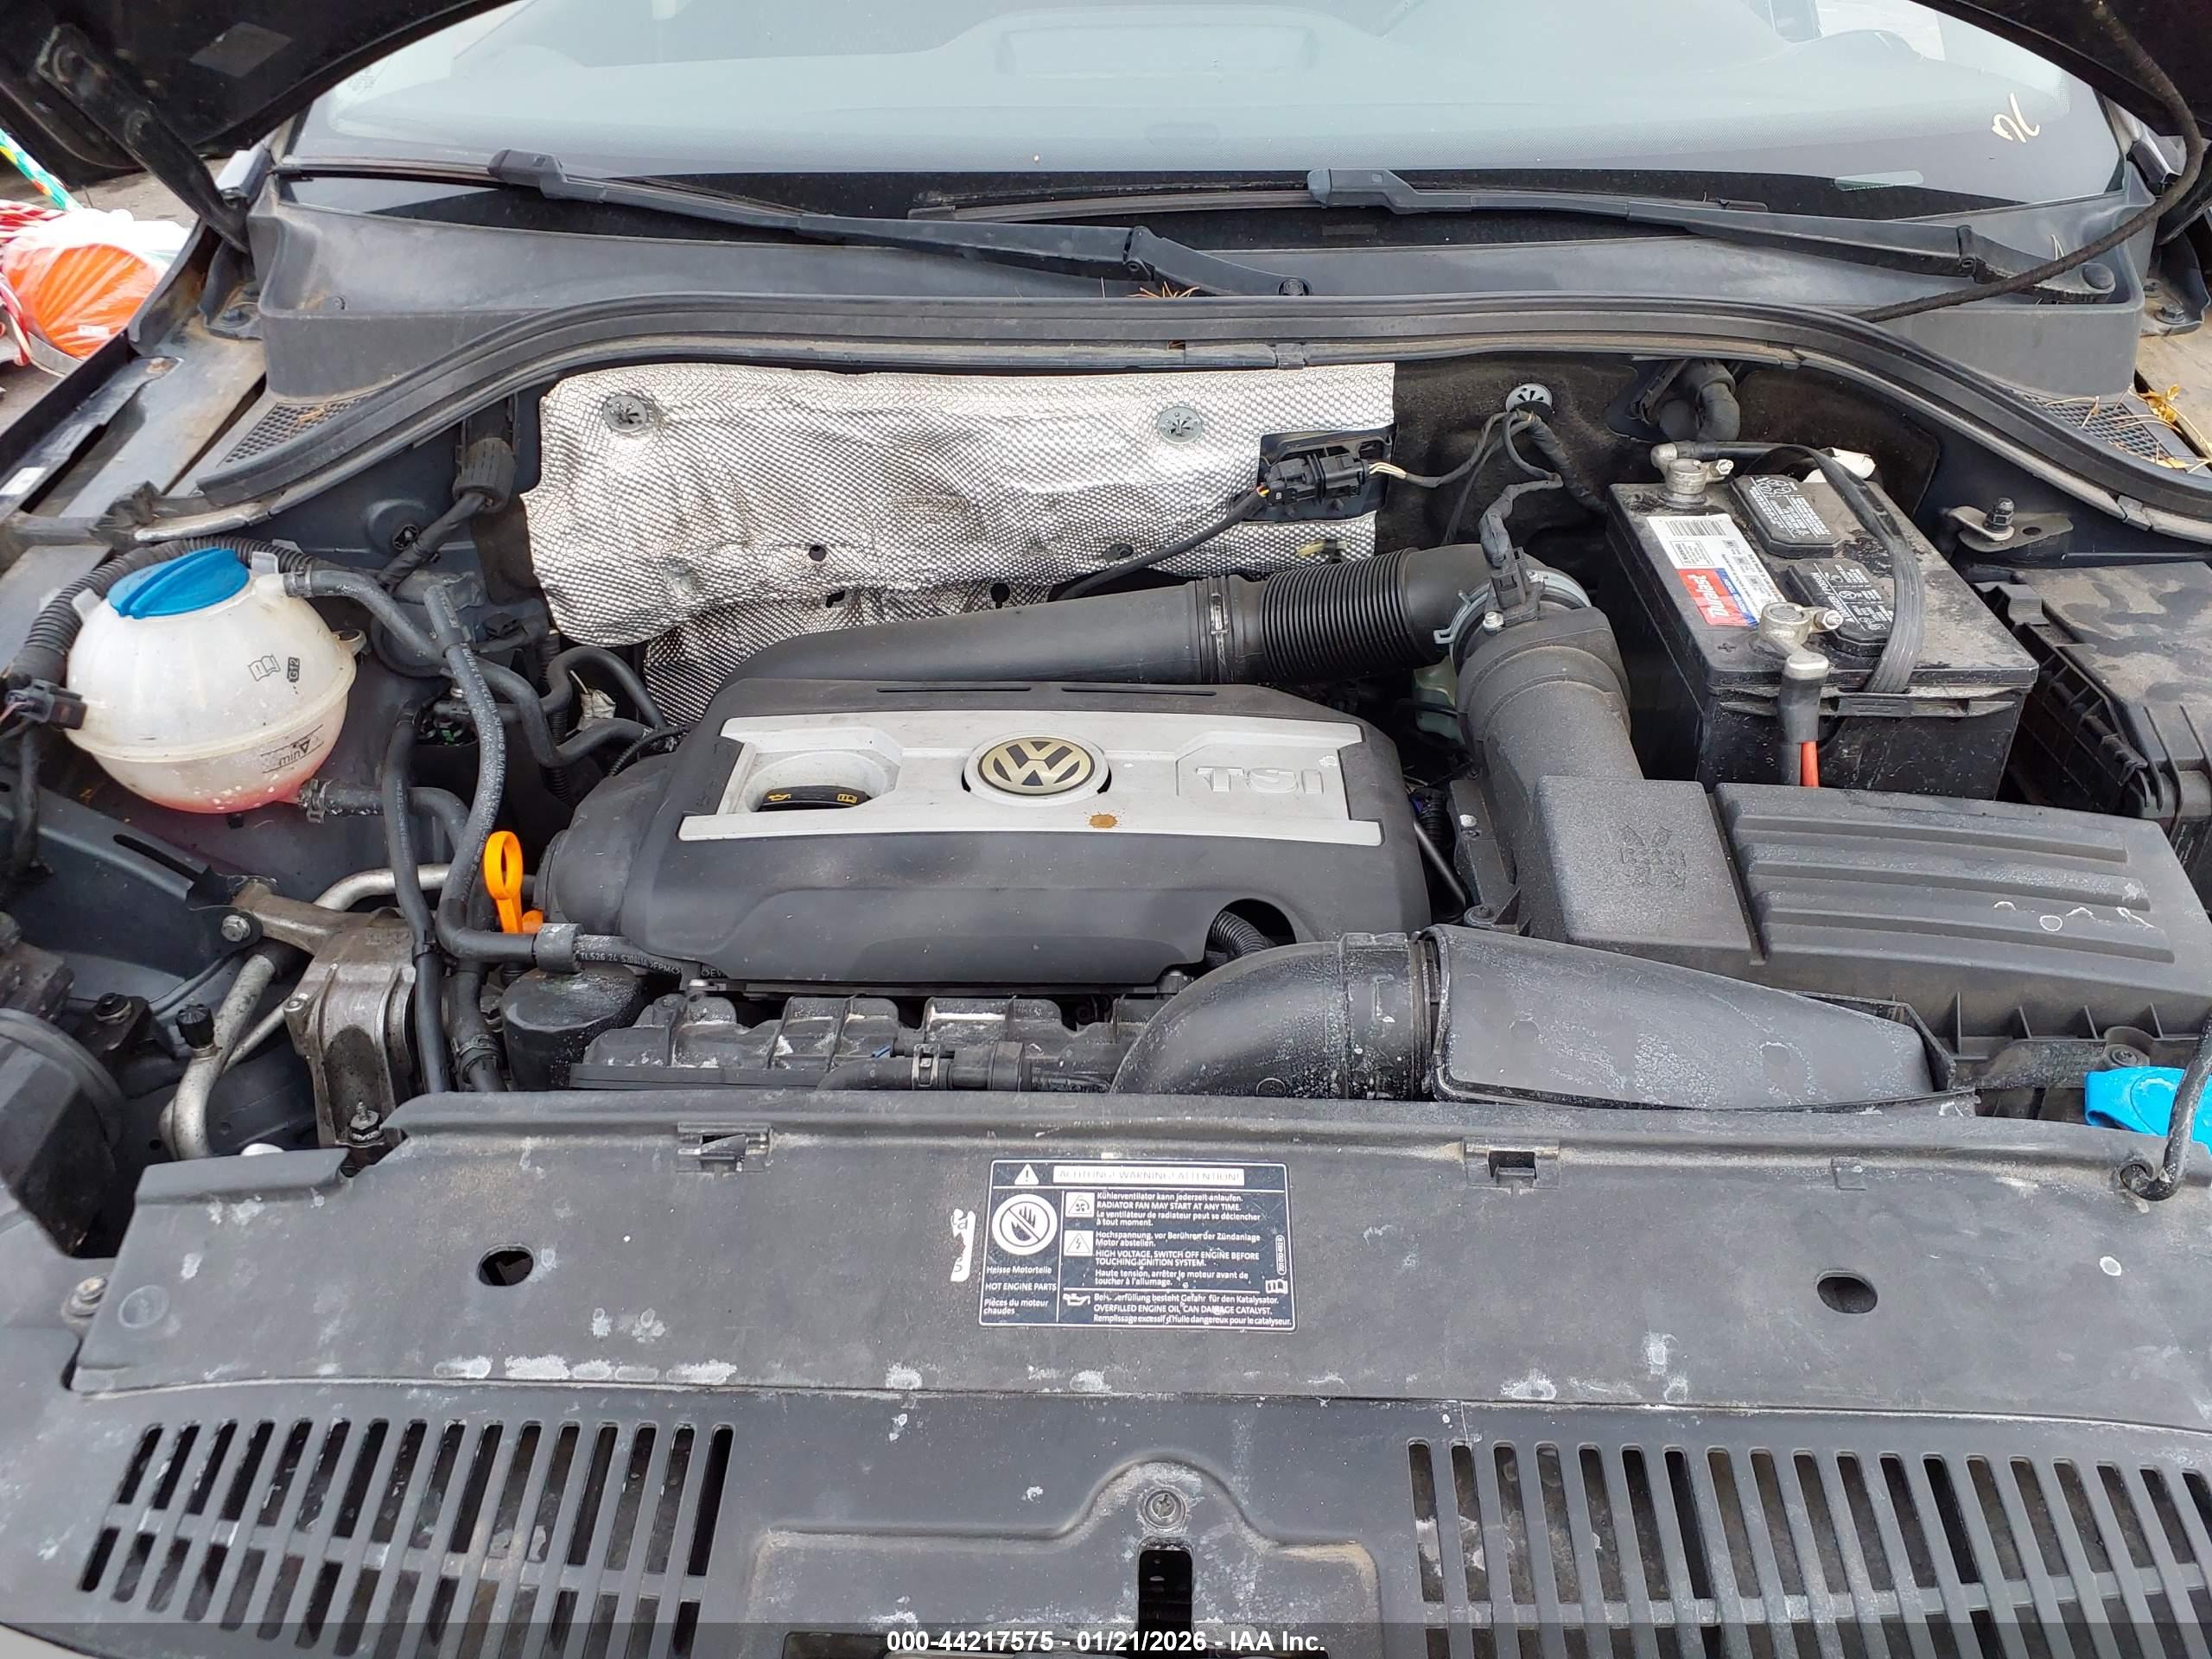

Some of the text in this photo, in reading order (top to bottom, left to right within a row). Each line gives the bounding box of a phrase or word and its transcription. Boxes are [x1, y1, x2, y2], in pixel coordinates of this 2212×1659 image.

[1810, 572, 1831, 591] POISON
[1686, 574, 1731, 619] Duralast
[1827, 595, 1851, 617] DANGER
[289, 659, 299, 680] G12
[278, 749, 301, 767] min
[1196, 766, 1325, 794] TSI
[1176, 1192, 1207, 1202] jederzeit
[1209, 1193, 1243, 1202] anlaufen.
[1158, 1211, 1191, 1220] radiateur
[1193, 1211, 1210, 1221] peut
[1204, 1231, 1216, 1240] der
[1217, 1232, 1261, 1243] Zündanlage
[1138, 1258, 1173, 1267] IGNITION
[1121, 1269, 1150, 1278] tension,
[1034, 1283, 1057, 1292] PARTS
[1152, 1294, 1179, 1302] besteht
[1181, 1294, 1205, 1302] Gefahr
[1236, 1295, 1279, 1305] Katalysator.
[1236, 1306, 1273, 1315] CATALYST.
[1094, 1314, 1137, 1324] Remplissage
[1191, 1315, 1228, 1325] dangereux
[1230, 1317, 1246, 1325] pour
[1255, 1317, 1292, 1326] catalyseur.
